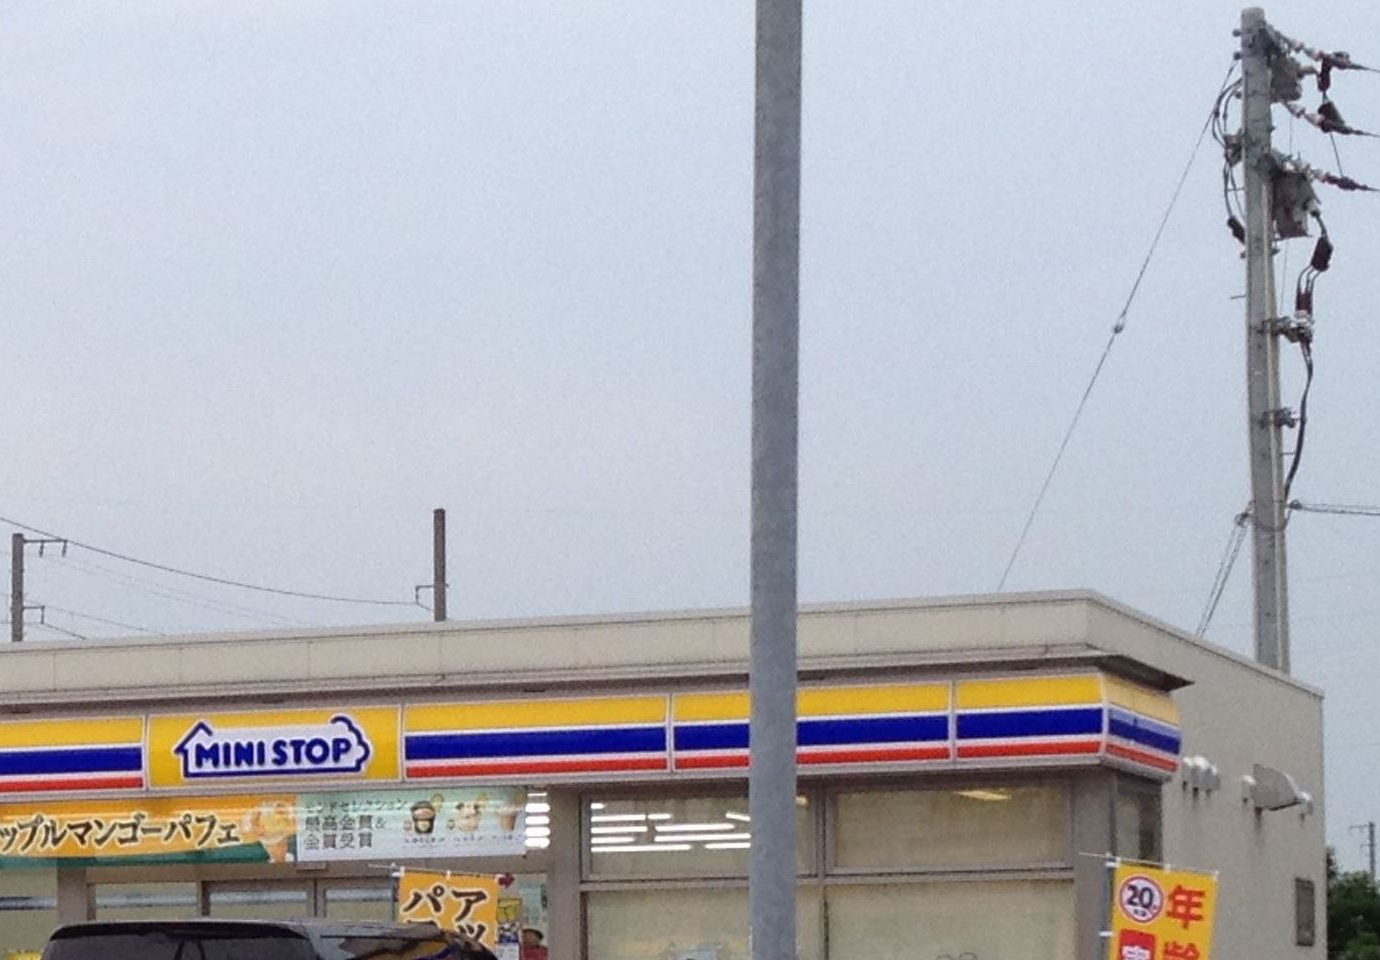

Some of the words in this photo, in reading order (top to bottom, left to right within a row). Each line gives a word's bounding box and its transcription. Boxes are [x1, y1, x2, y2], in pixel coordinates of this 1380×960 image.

[304, 832, 373, 850] 金賞受賞
[1127, 884, 1154, 909] 20
